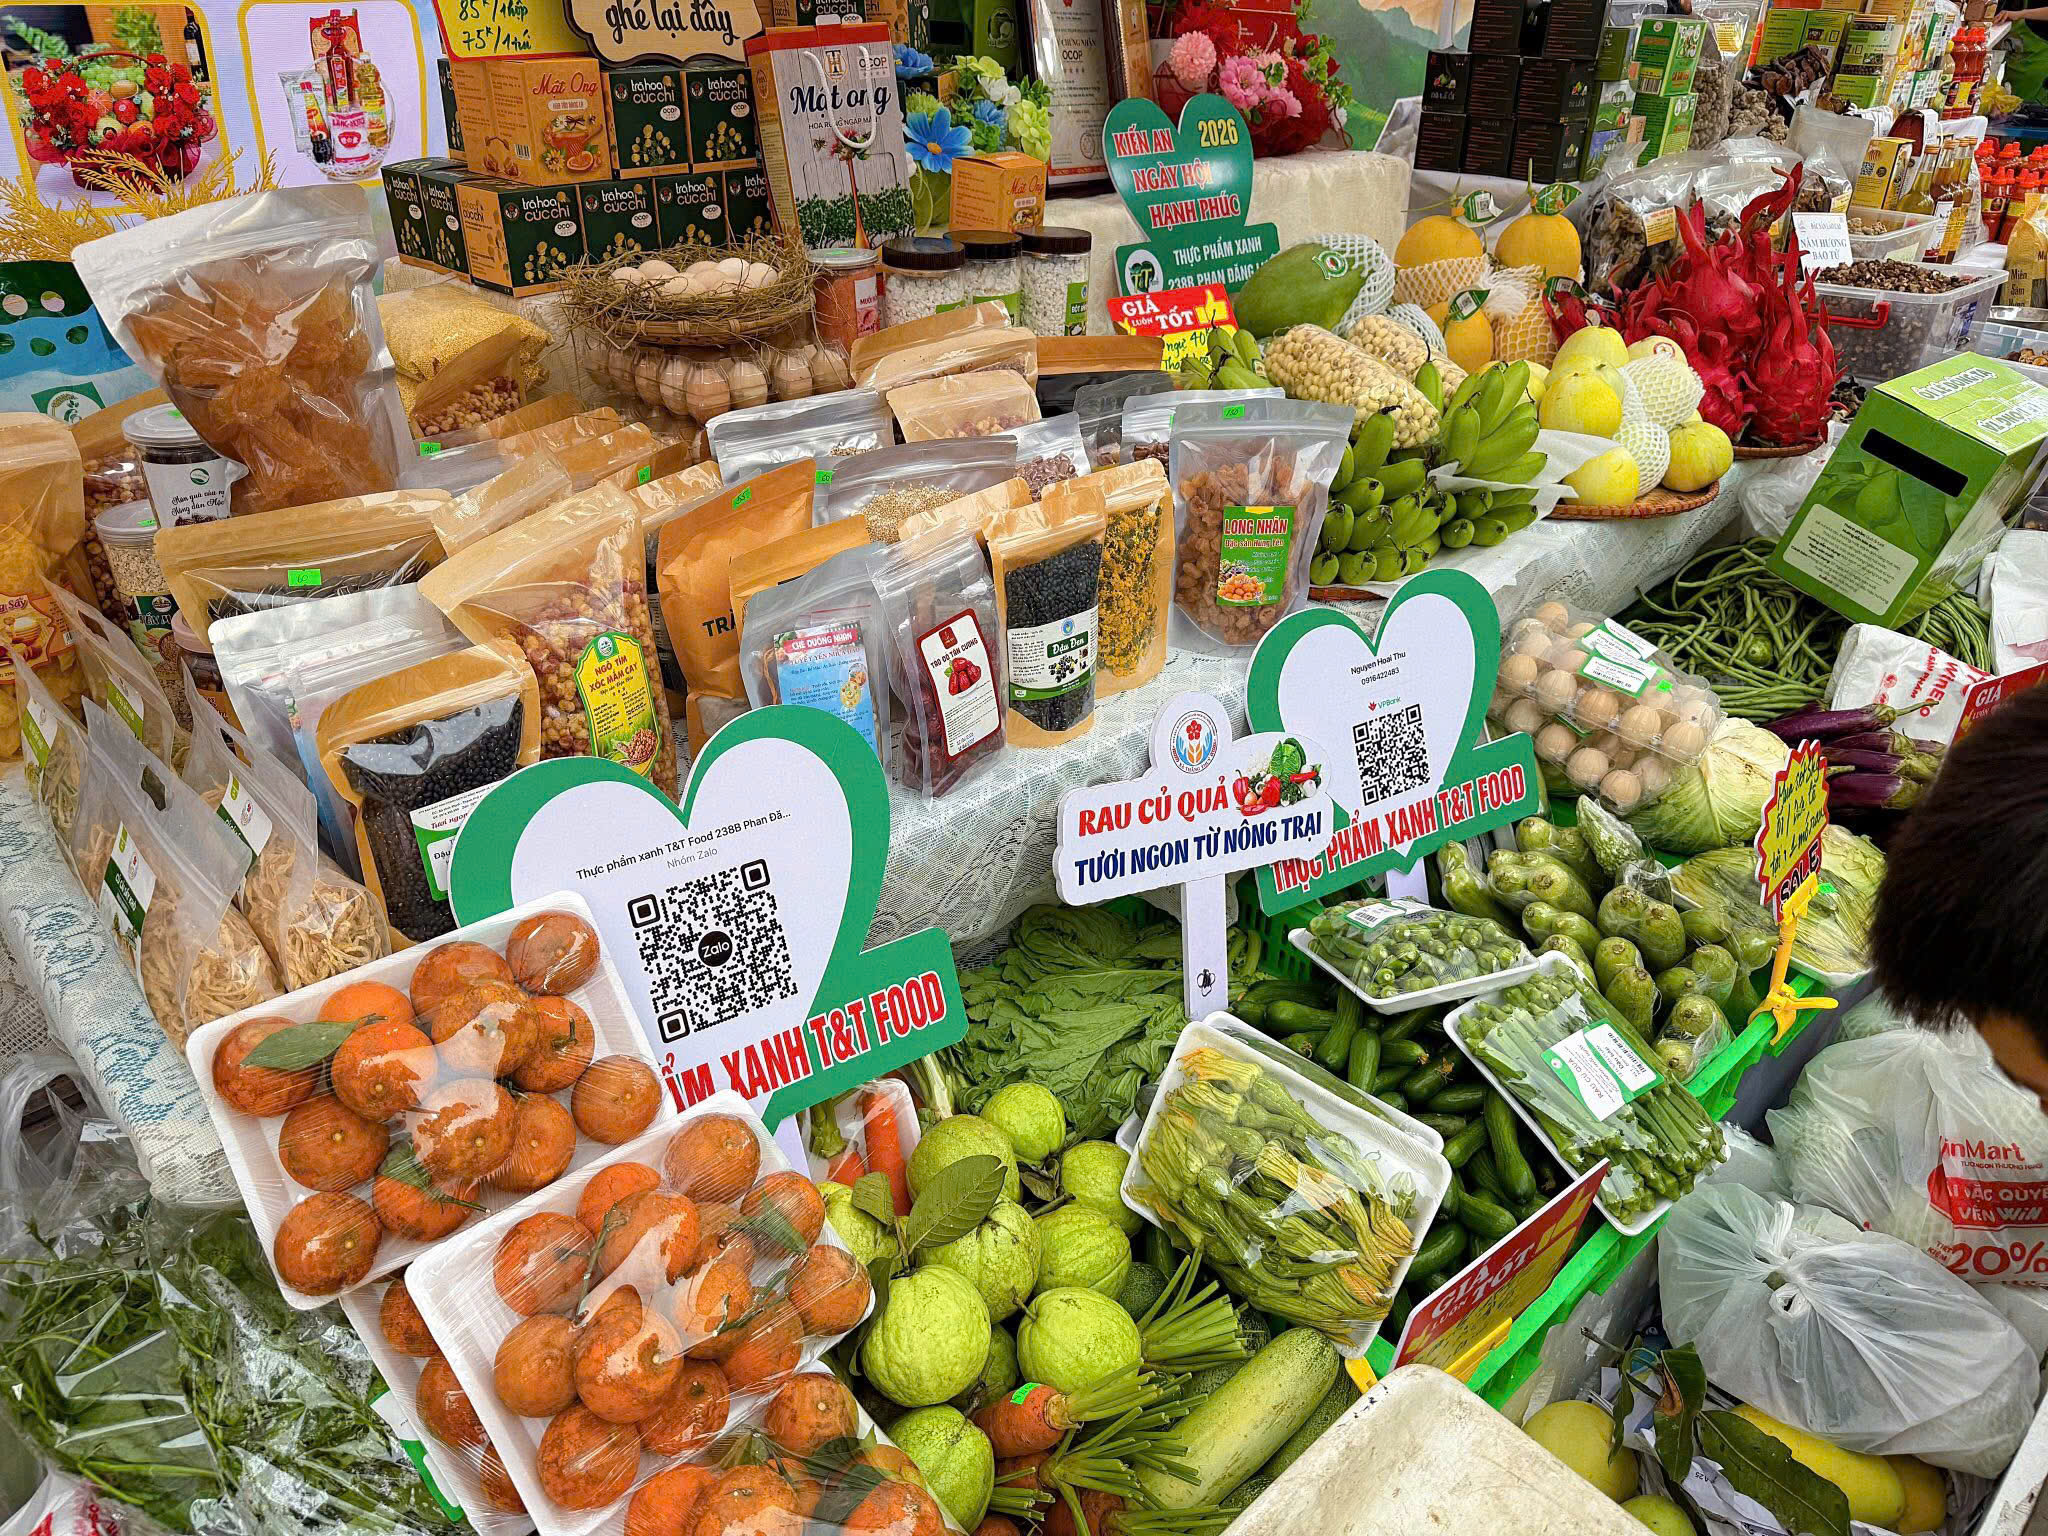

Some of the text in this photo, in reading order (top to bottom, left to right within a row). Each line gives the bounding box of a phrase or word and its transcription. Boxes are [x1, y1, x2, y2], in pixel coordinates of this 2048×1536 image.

[533, 72, 599, 98] Mật Ong
[1113, 123, 1175, 157] KIẾN AN
[1198, 119, 1239, 147] 2026
[1131, 161, 1178, 192] NGÀY
[1148, 190, 1241, 231] HẠNH PHÚC
[1173, 236, 1263, 267] THỰC PHẨM XANH
[1121, 295, 1160, 317] GIÁ
[1155, 305, 1194, 329] TỐT
[1223, 515, 1289, 536] LONG NHÃN
[1070, 637, 1085, 647] Đen
[624, 662, 638, 675] CAY
[1350, 661, 1377, 675] Nguyen
[1392, 651, 1406, 661] Thu
[1377, 696, 1401, 709] VPBank
[1078, 775, 1229, 837] RAU CỦ QUẢ
[1326, 809, 1384, 872] PHẨM
[1384, 796, 1438, 849] XANH
[1437, 780, 1475, 828] T&T
[1475, 763, 1527, 813] FOOD
[575, 863, 605, 881] Thực
[606, 851, 638, 875] phẩm
[638, 846, 665, 863] xanh
[664, 839, 687, 854] T&T
[687, 830, 715, 847] Food
[715, 822, 742, 840] 238B
[742, 815, 769, 831] Phan
[666, 846, 719, 870] Nhóm Zalo
[1074, 811, 1323, 886] TƯƠI NGON TỪ NÔNG TRẠI
[701, 939, 731, 960] Zalo
[719, 1024, 812, 1101] XANH
[809, 997, 870, 1071] T&T
[869, 970, 949, 1048] FOOD
[1945, 1240, 2048, 1276] 20%
[1431, 1257, 1493, 1320] GIÁ
[1470, 1242, 1536, 1306] TỐT
